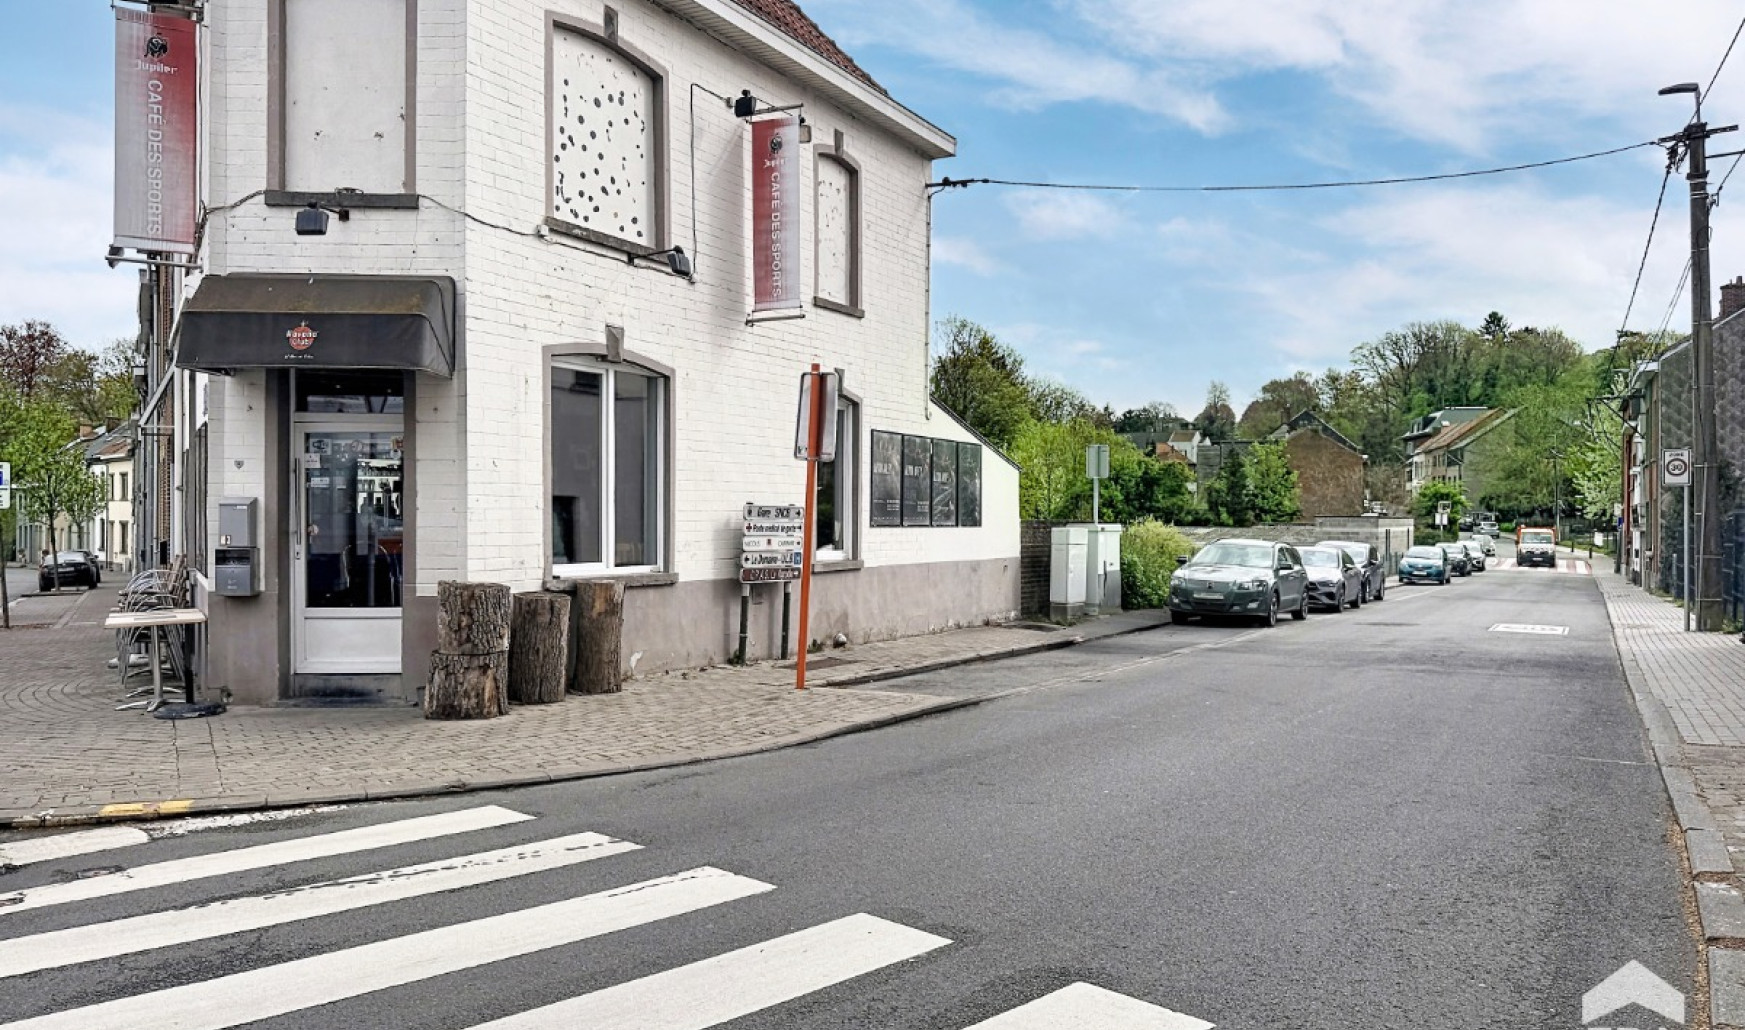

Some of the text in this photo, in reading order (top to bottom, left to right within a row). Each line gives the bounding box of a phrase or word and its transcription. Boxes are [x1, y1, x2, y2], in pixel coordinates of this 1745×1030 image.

[135, 60, 178, 74] Jupiler
[147, 130, 163, 163] DES
[147, 167, 163, 235] SPORTS
[770, 213, 782, 239] DES
[771, 243, 783, 297] SPORTS
